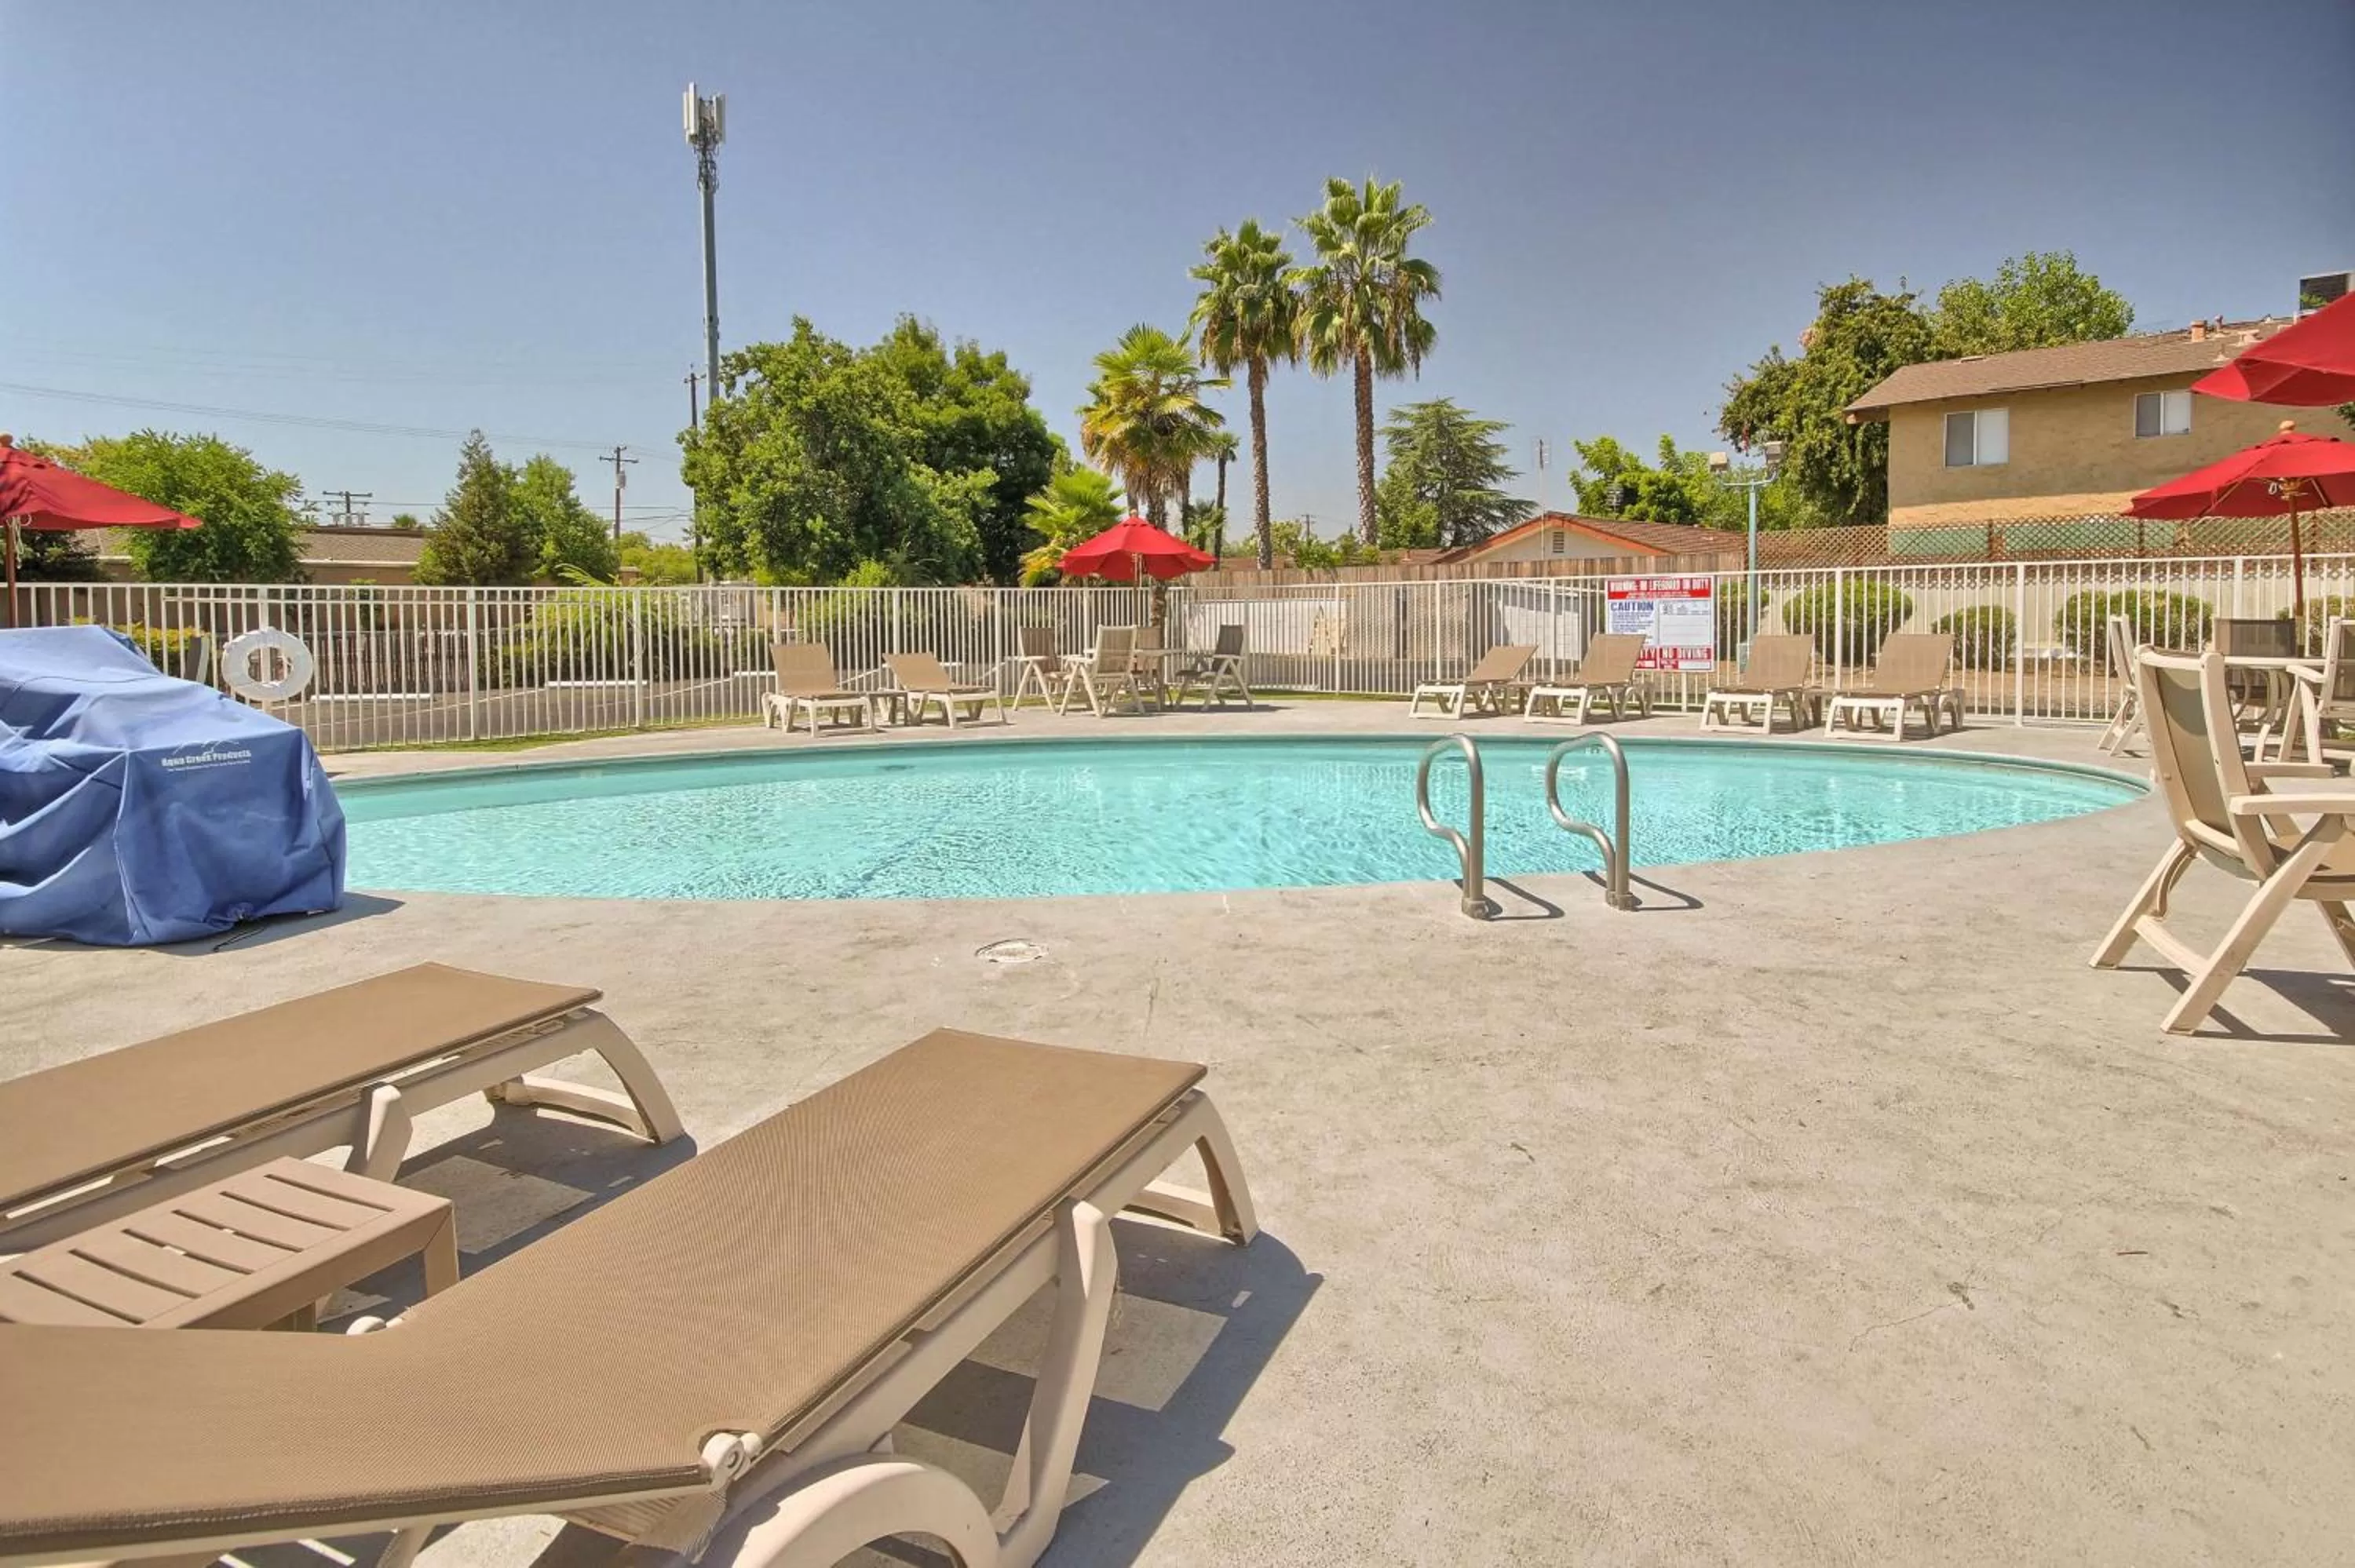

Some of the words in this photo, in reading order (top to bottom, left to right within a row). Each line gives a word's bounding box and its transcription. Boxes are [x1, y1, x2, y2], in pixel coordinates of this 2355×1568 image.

[1692, 578, 1709, 589] DUTY
[1611, 601, 1654, 611] CAUTION
[1662, 649, 1674, 658] NO
[1678, 648, 1708, 658] DIVING
[161, 757, 184, 767] Aqua
[186, 755, 212, 764] Creek
[213, 750, 251, 761] Products
